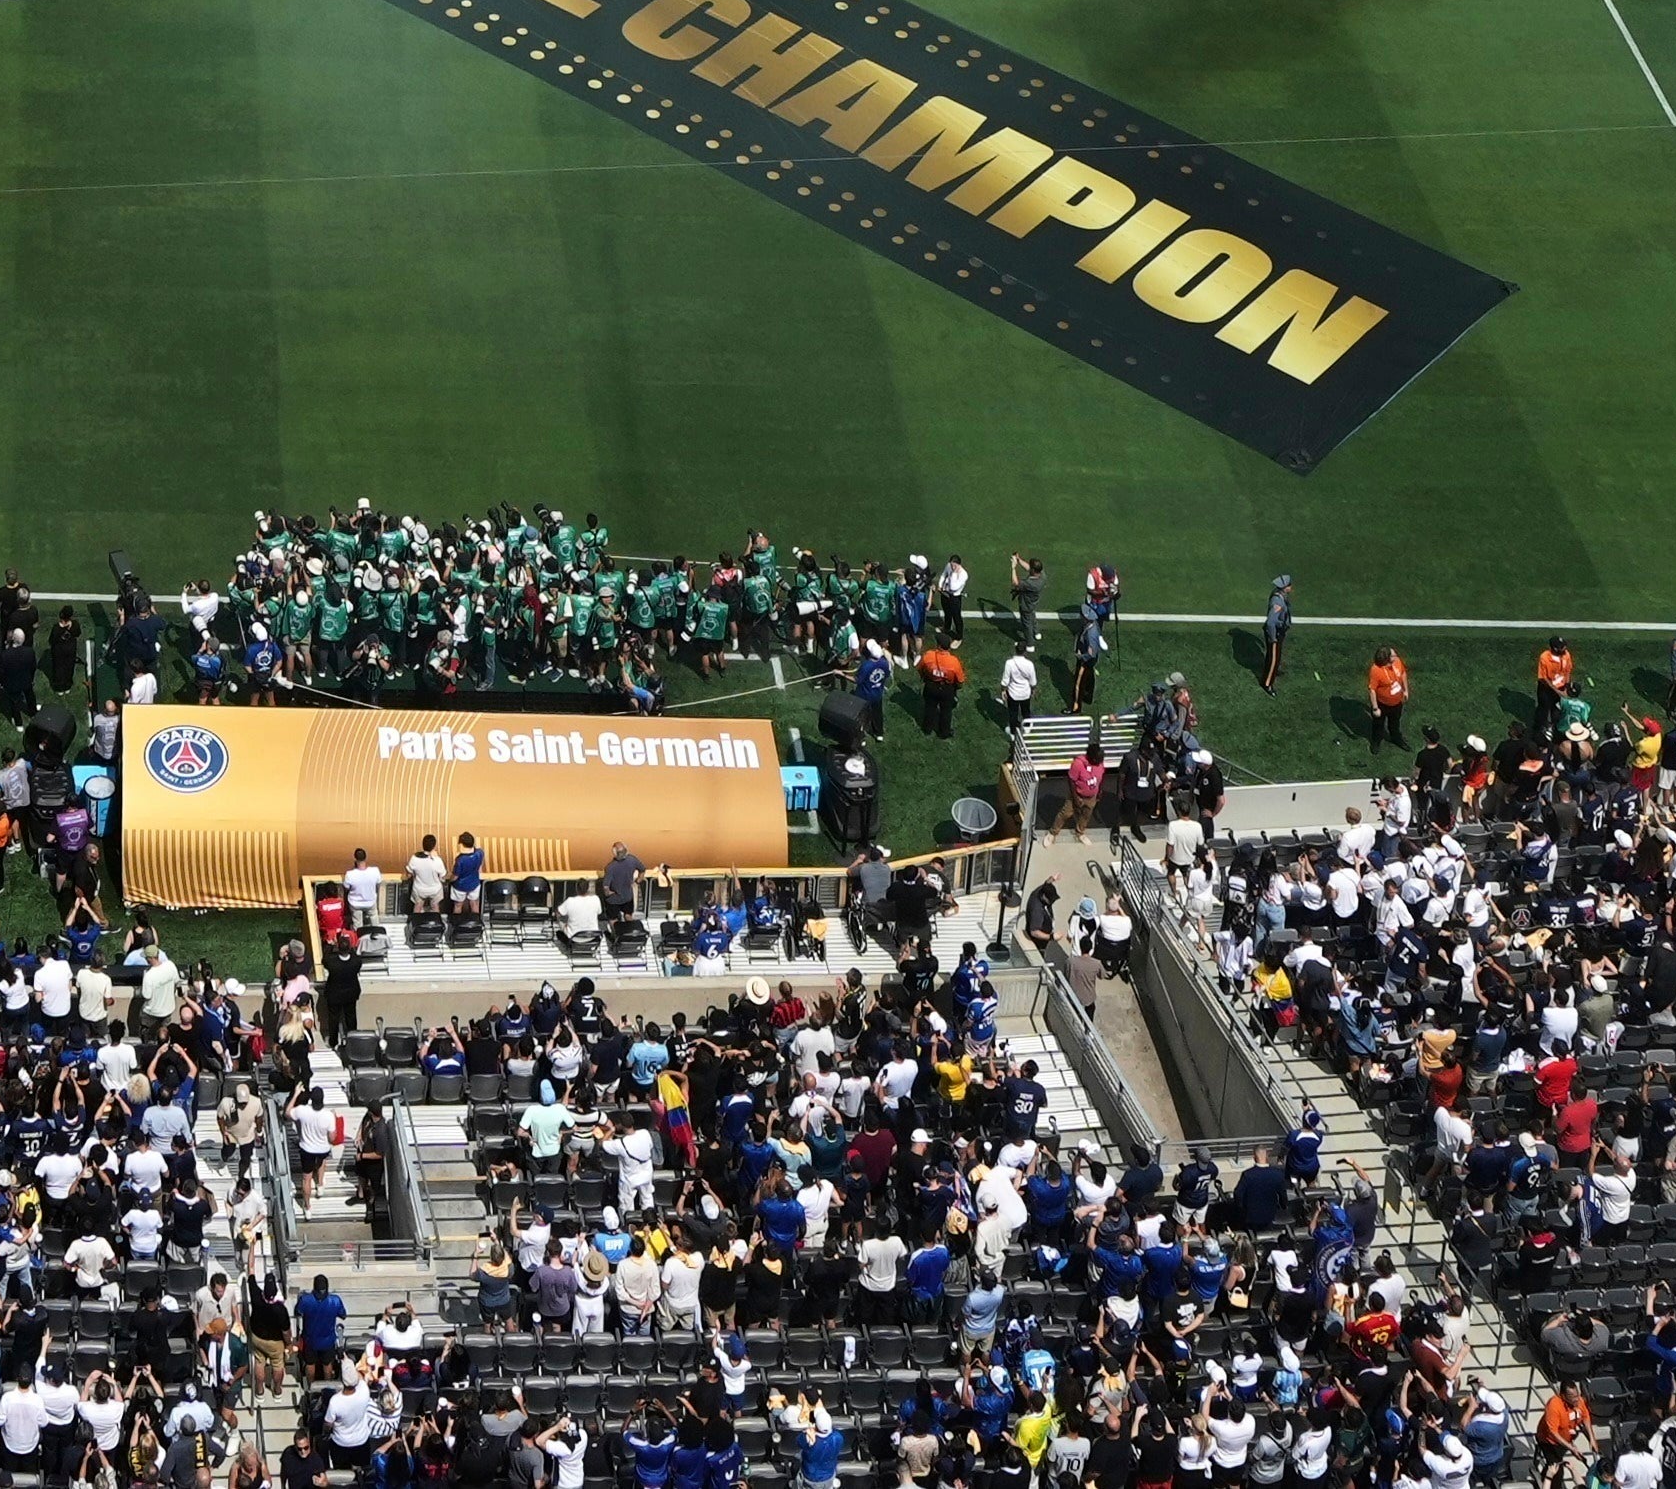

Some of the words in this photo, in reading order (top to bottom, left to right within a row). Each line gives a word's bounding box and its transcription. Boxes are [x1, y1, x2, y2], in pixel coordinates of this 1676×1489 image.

[157, 728, 214, 745] PARIS
[378, 726, 476, 761] Paris
[487, 729, 760, 768] Saint-Germain
[706, 944, 718, 959] 6
[1014, 1099, 1034, 1114] 30
[1374, 1331, 1389, 1345] 19
[1066, 1457, 1081, 1471] 10
